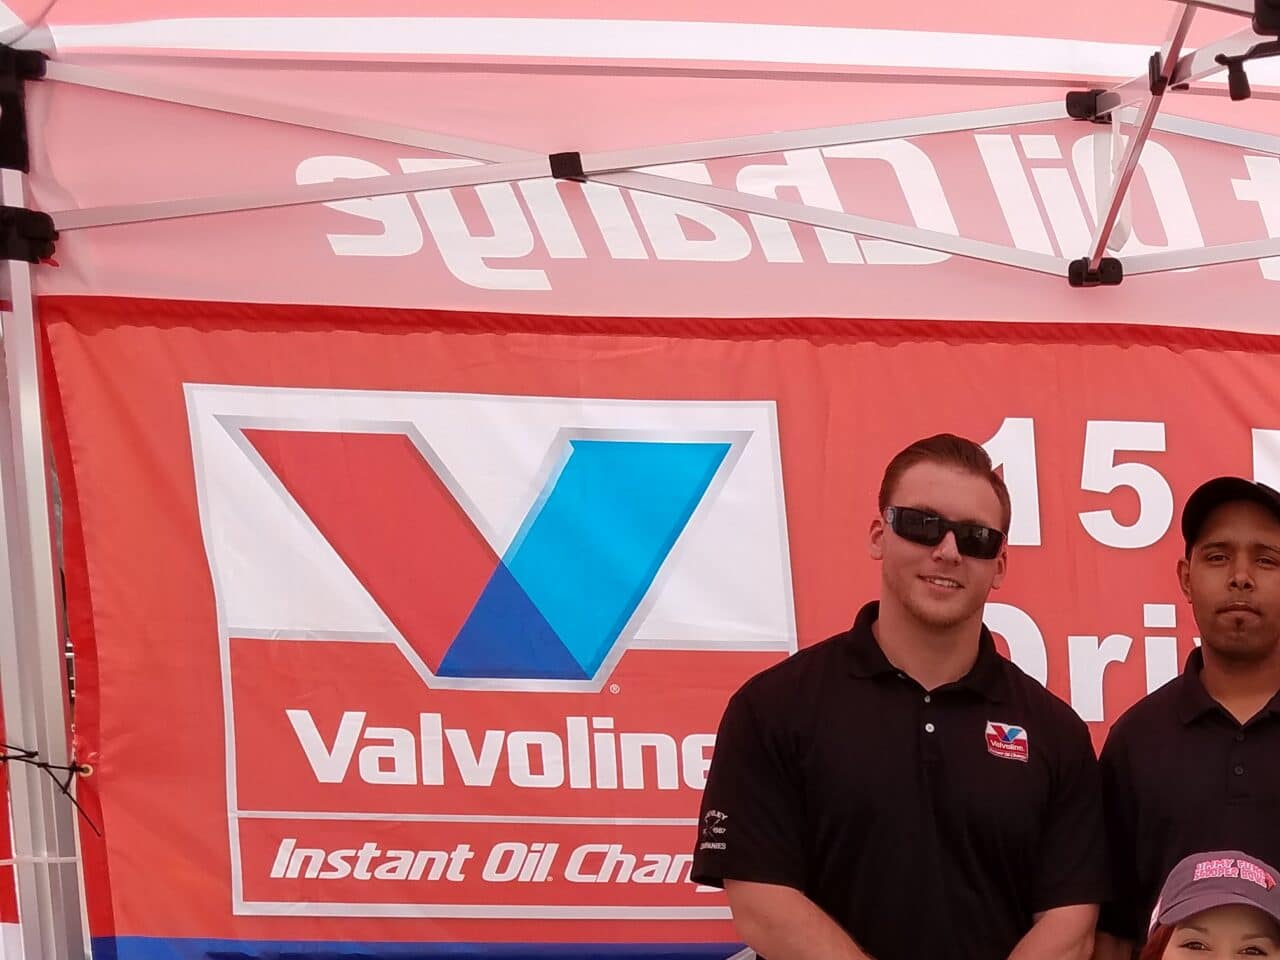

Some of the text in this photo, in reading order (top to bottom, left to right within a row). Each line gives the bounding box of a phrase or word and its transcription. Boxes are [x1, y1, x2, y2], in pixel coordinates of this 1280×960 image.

[986, 417, 1175, 550] 15
[286, 709, 717, 790] Valvoline
[270, 838, 725, 893] Instant Oil Chan
